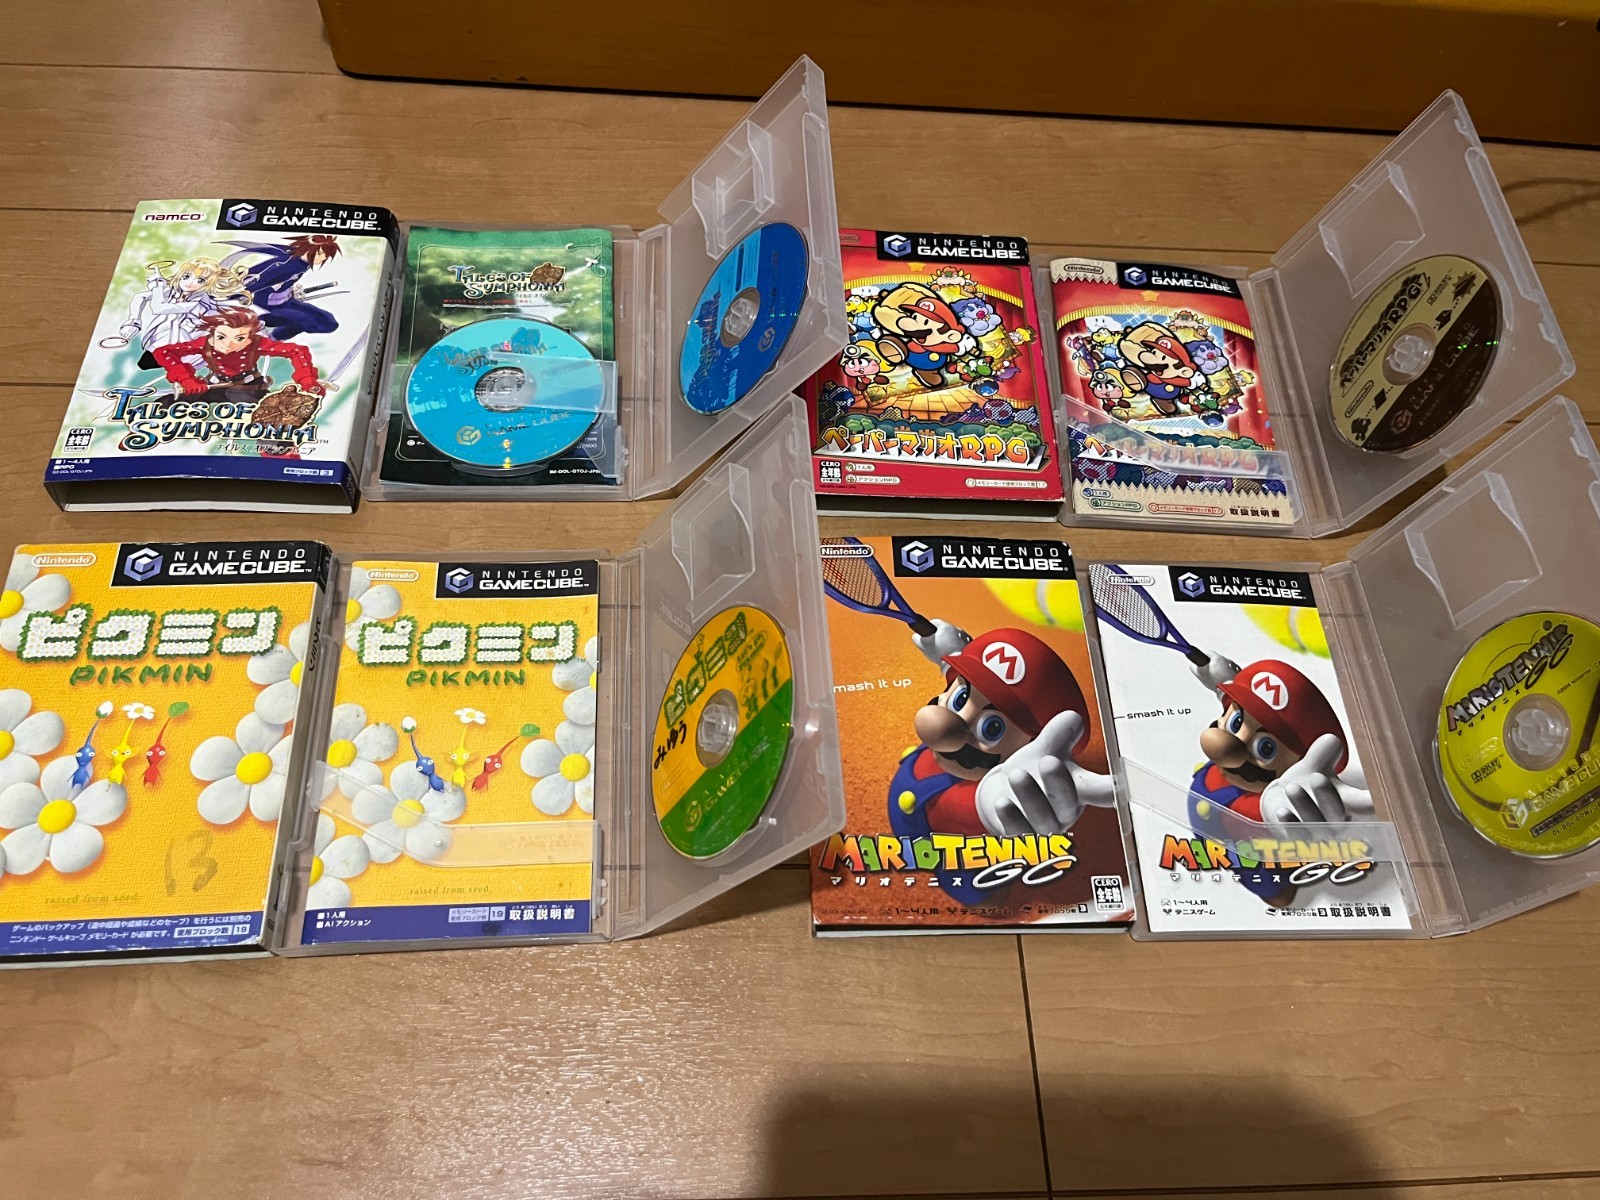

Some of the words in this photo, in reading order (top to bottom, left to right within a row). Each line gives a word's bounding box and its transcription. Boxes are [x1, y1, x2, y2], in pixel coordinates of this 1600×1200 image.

[145, 213, 201, 221] namco
[267, 206, 378, 220] NINTENDO
[262, 216, 379, 231] GAMECUBE
[919, 238, 1017, 250] NINTENDO
[917, 246, 1022, 259] GAMECUBE
[447, 265, 507, 283] TALES
[510, 273, 531, 282] OF
[1152, 270, 1228, 286] NINTENDO
[1151, 277, 1232, 293] GAMECUBE
[104, 387, 209, 422] TALES
[213, 402, 256, 420] OF
[119, 420, 318, 451] SYMPHONIA
[823, 426, 1029, 463] ペーパーマリオRPG
[174, 549, 305, 560] NINTENDO
[942, 544, 1059, 557] NINTENDO
[36, 555, 92, 565] Nintendo
[941, 555, 1064, 571] GAMECUBE
[169, 560, 305, 575] GAMECUBE
[482, 569, 583, 579] NINTENDO
[370, 571, 416, 579] Nintendo
[1210, 575, 1298, 588] NINTENDO
[479, 578, 584, 589] GAMECUBE
[1210, 585, 1302, 599] GAMECUBE
[17, 603, 282, 662] ピクミン
[357, 615, 579, 667] ピクミン
[70, 663, 213, 686] PIKMIN
[406, 669, 527, 687] PIKMIN
[833, 681, 874, 693] mash
[893, 678, 912, 688] up
[1127, 709, 1164, 719] smash
[972, 855, 1077, 888] GC
[1169, 872, 1281, 883] マリオテニス
[1289, 857, 1375, 885] GC
[830, 876, 962, 887] マリオテニス
[1095, 878, 1118, 886] CERO
[410, 886, 439, 895] raised
[443, 886, 465, 894] from
[468, 885, 489, 893] seed
[1096, 888, 1121, 903] 全年齢
[491, 910, 504, 918] 19
[509, 908, 575, 920] 取扱説明書
[1330, 906, 1391, 917] 取扱説明書
